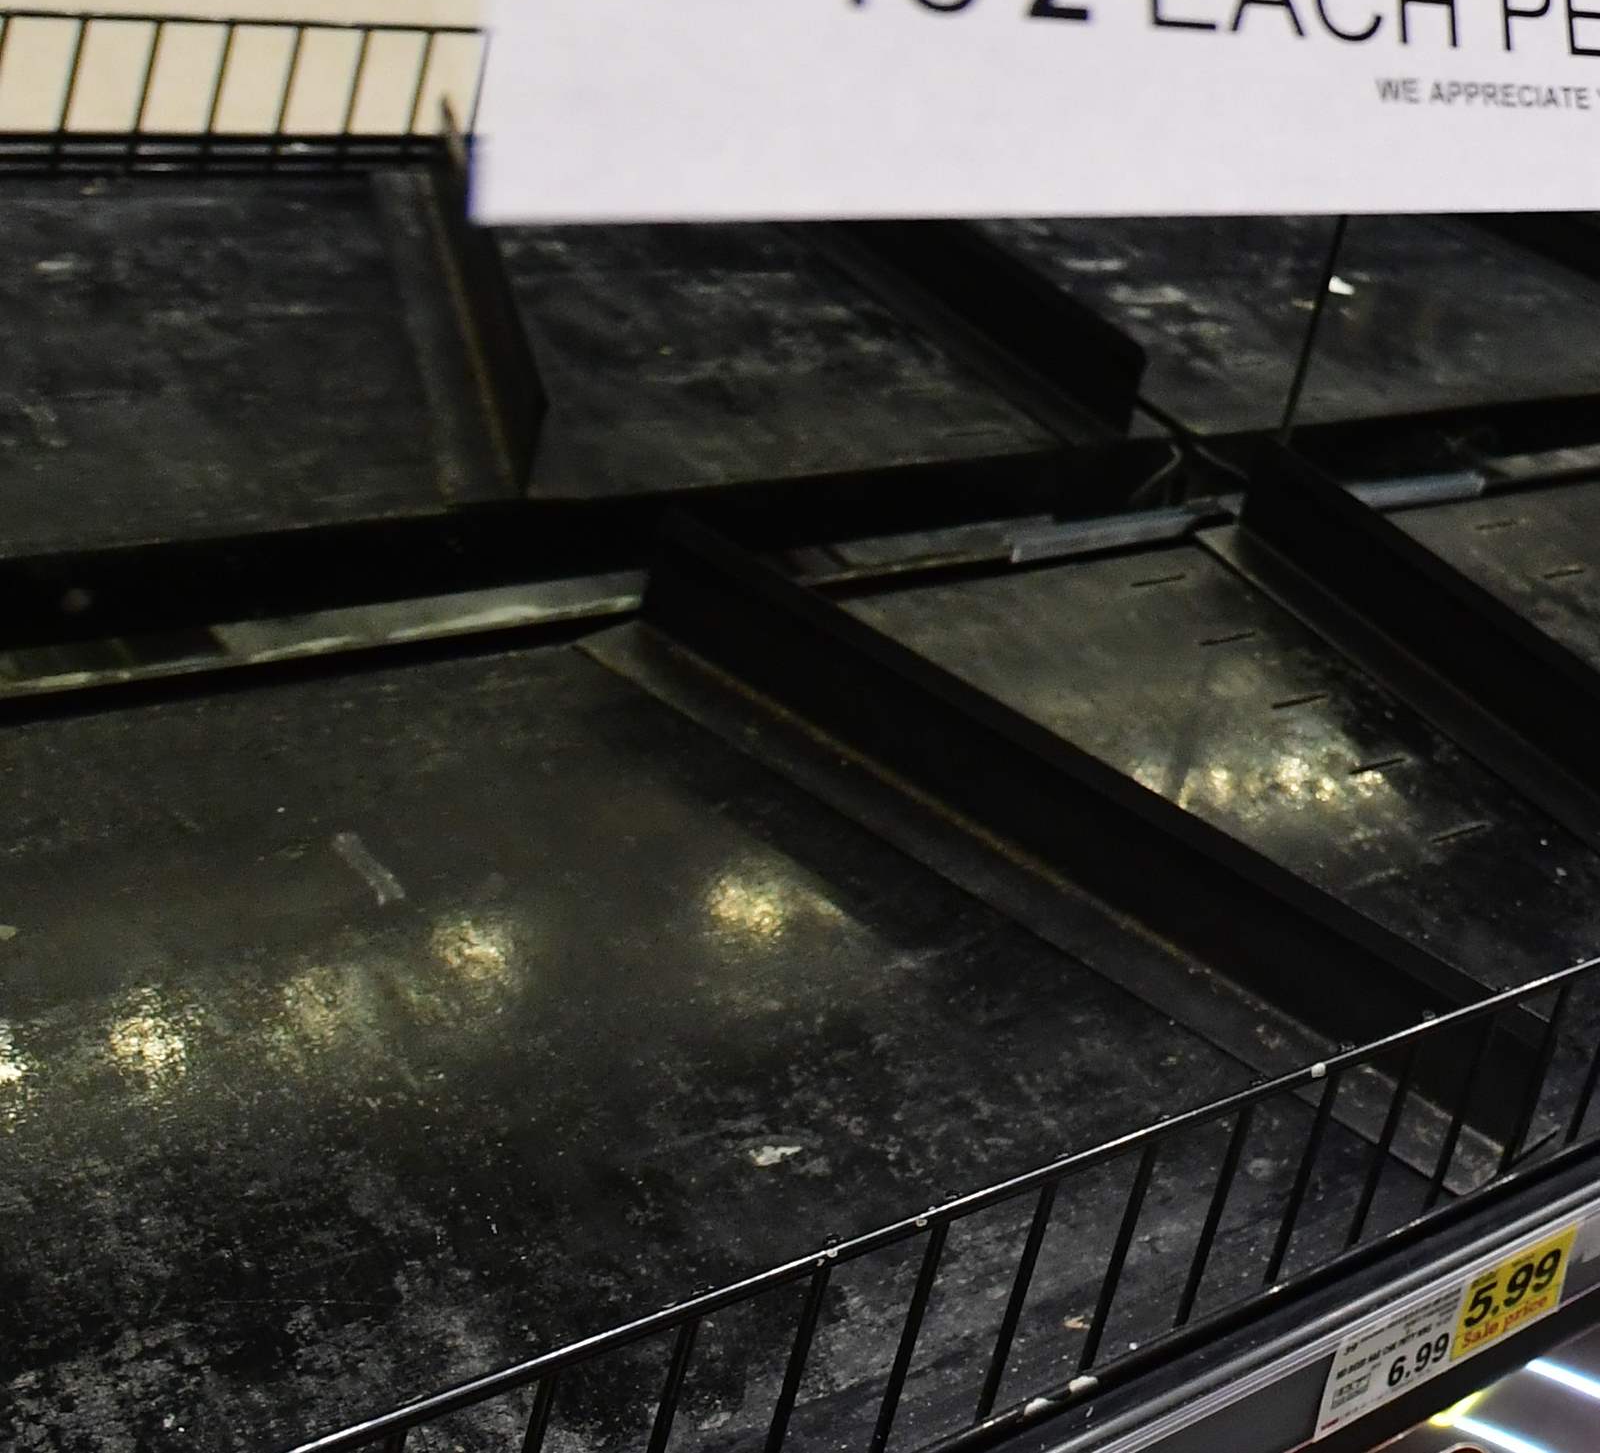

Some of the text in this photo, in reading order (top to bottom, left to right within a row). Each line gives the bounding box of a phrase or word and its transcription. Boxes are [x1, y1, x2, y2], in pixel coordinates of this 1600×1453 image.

[1377, 79, 1420, 104] WE
[1430, 81, 1590, 110] APPRECIATE
[1463, 1248, 1562, 1328] 5.99
[1463, 1320, 1497, 1347] Sale
[1499, 1294, 1549, 1340] price
[1387, 1333, 1450, 1387] 6.99
